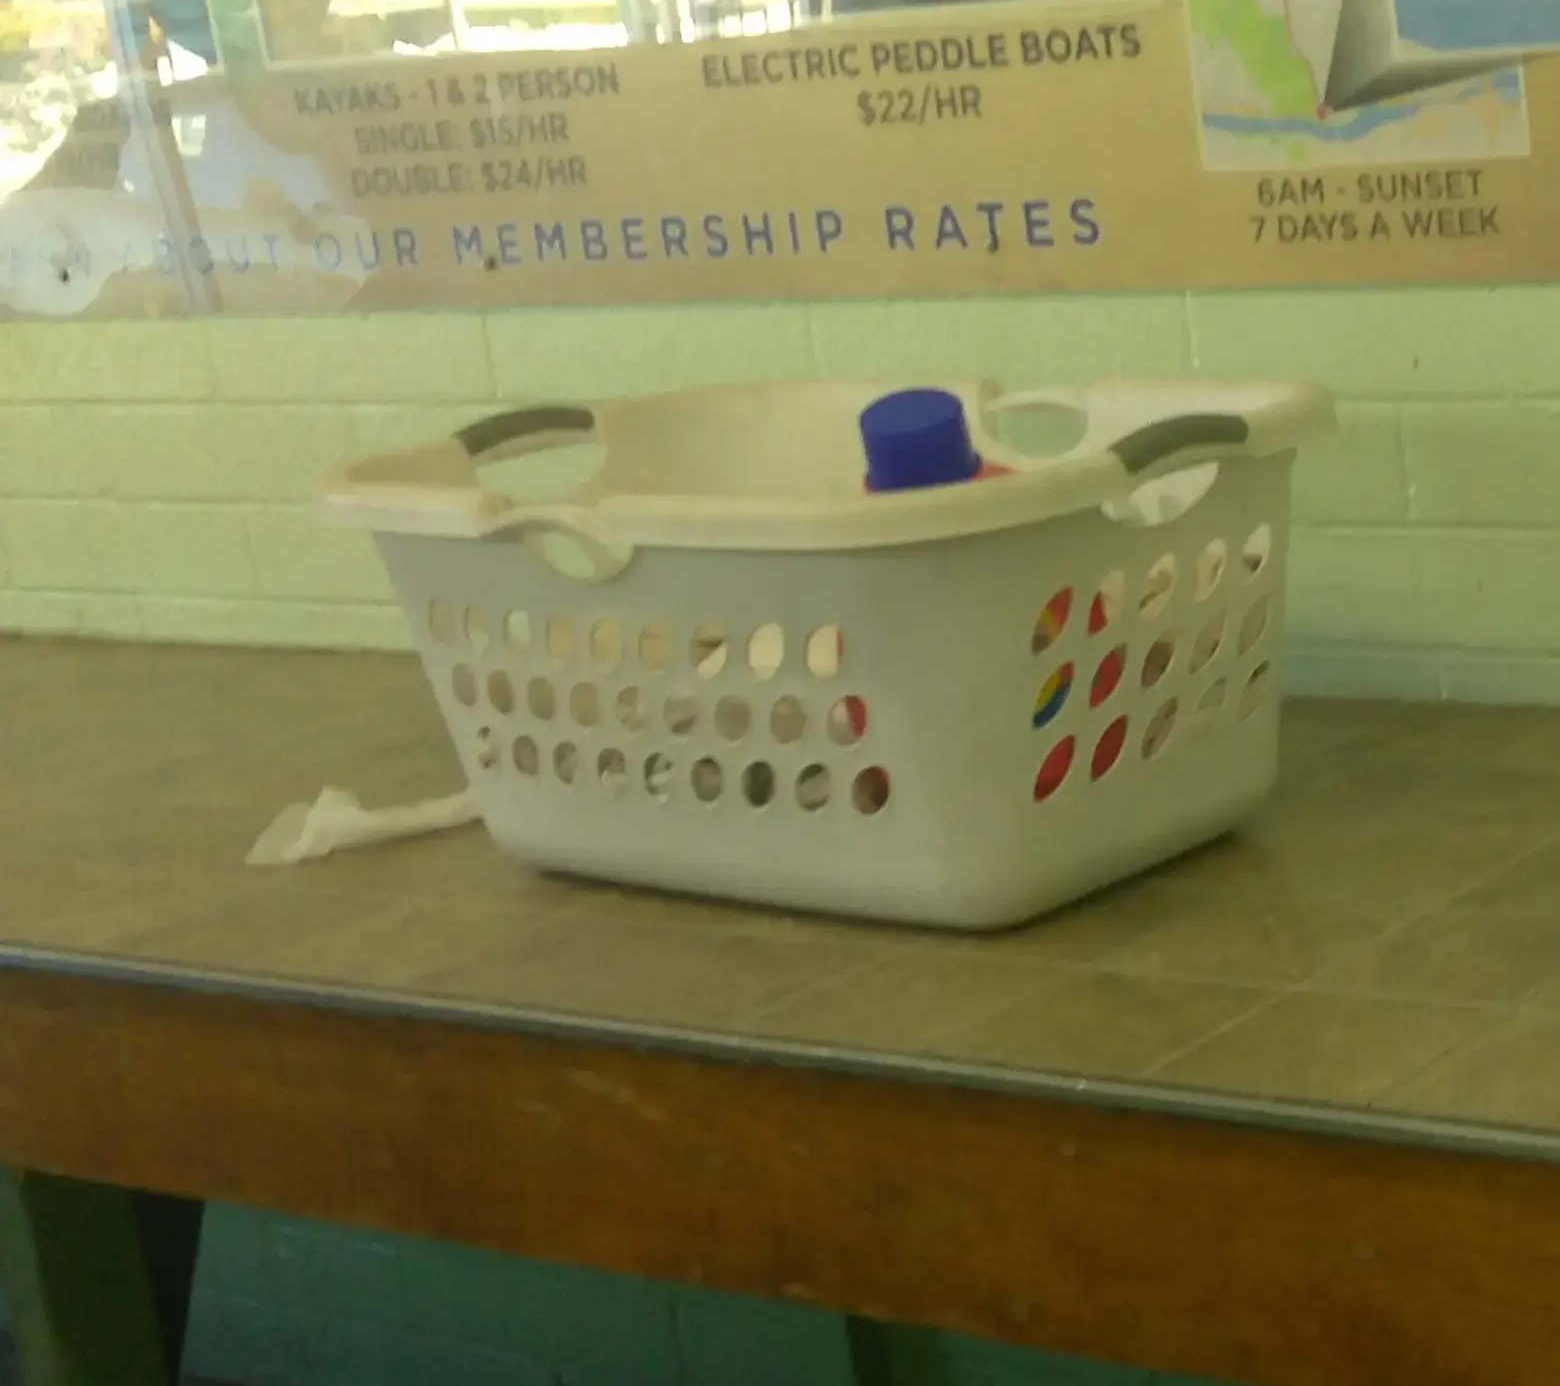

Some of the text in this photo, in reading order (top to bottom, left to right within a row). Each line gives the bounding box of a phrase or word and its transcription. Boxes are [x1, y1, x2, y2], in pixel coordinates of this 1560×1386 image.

[702, 23, 1142, 89] ELECTRIC PEDDLE BOATS
[294, 87, 401, 117] KAYAKS
[473, 73, 490, 104] 2
[499, 62, 620, 102] PERSON
[857, 84, 982, 127] $22/HR
[480, 154, 588, 193] $24/HR
[1257, 177, 1325, 206] 6AM
[1357, 170, 1484, 203] SUNSET
[313, 228, 420, 270] OUR
[453, 209, 843, 266] MEMBERSHIP
[885, 198, 1101, 254] RATES
[1250, 206, 1500, 244] 7 DAYS A WEEK
